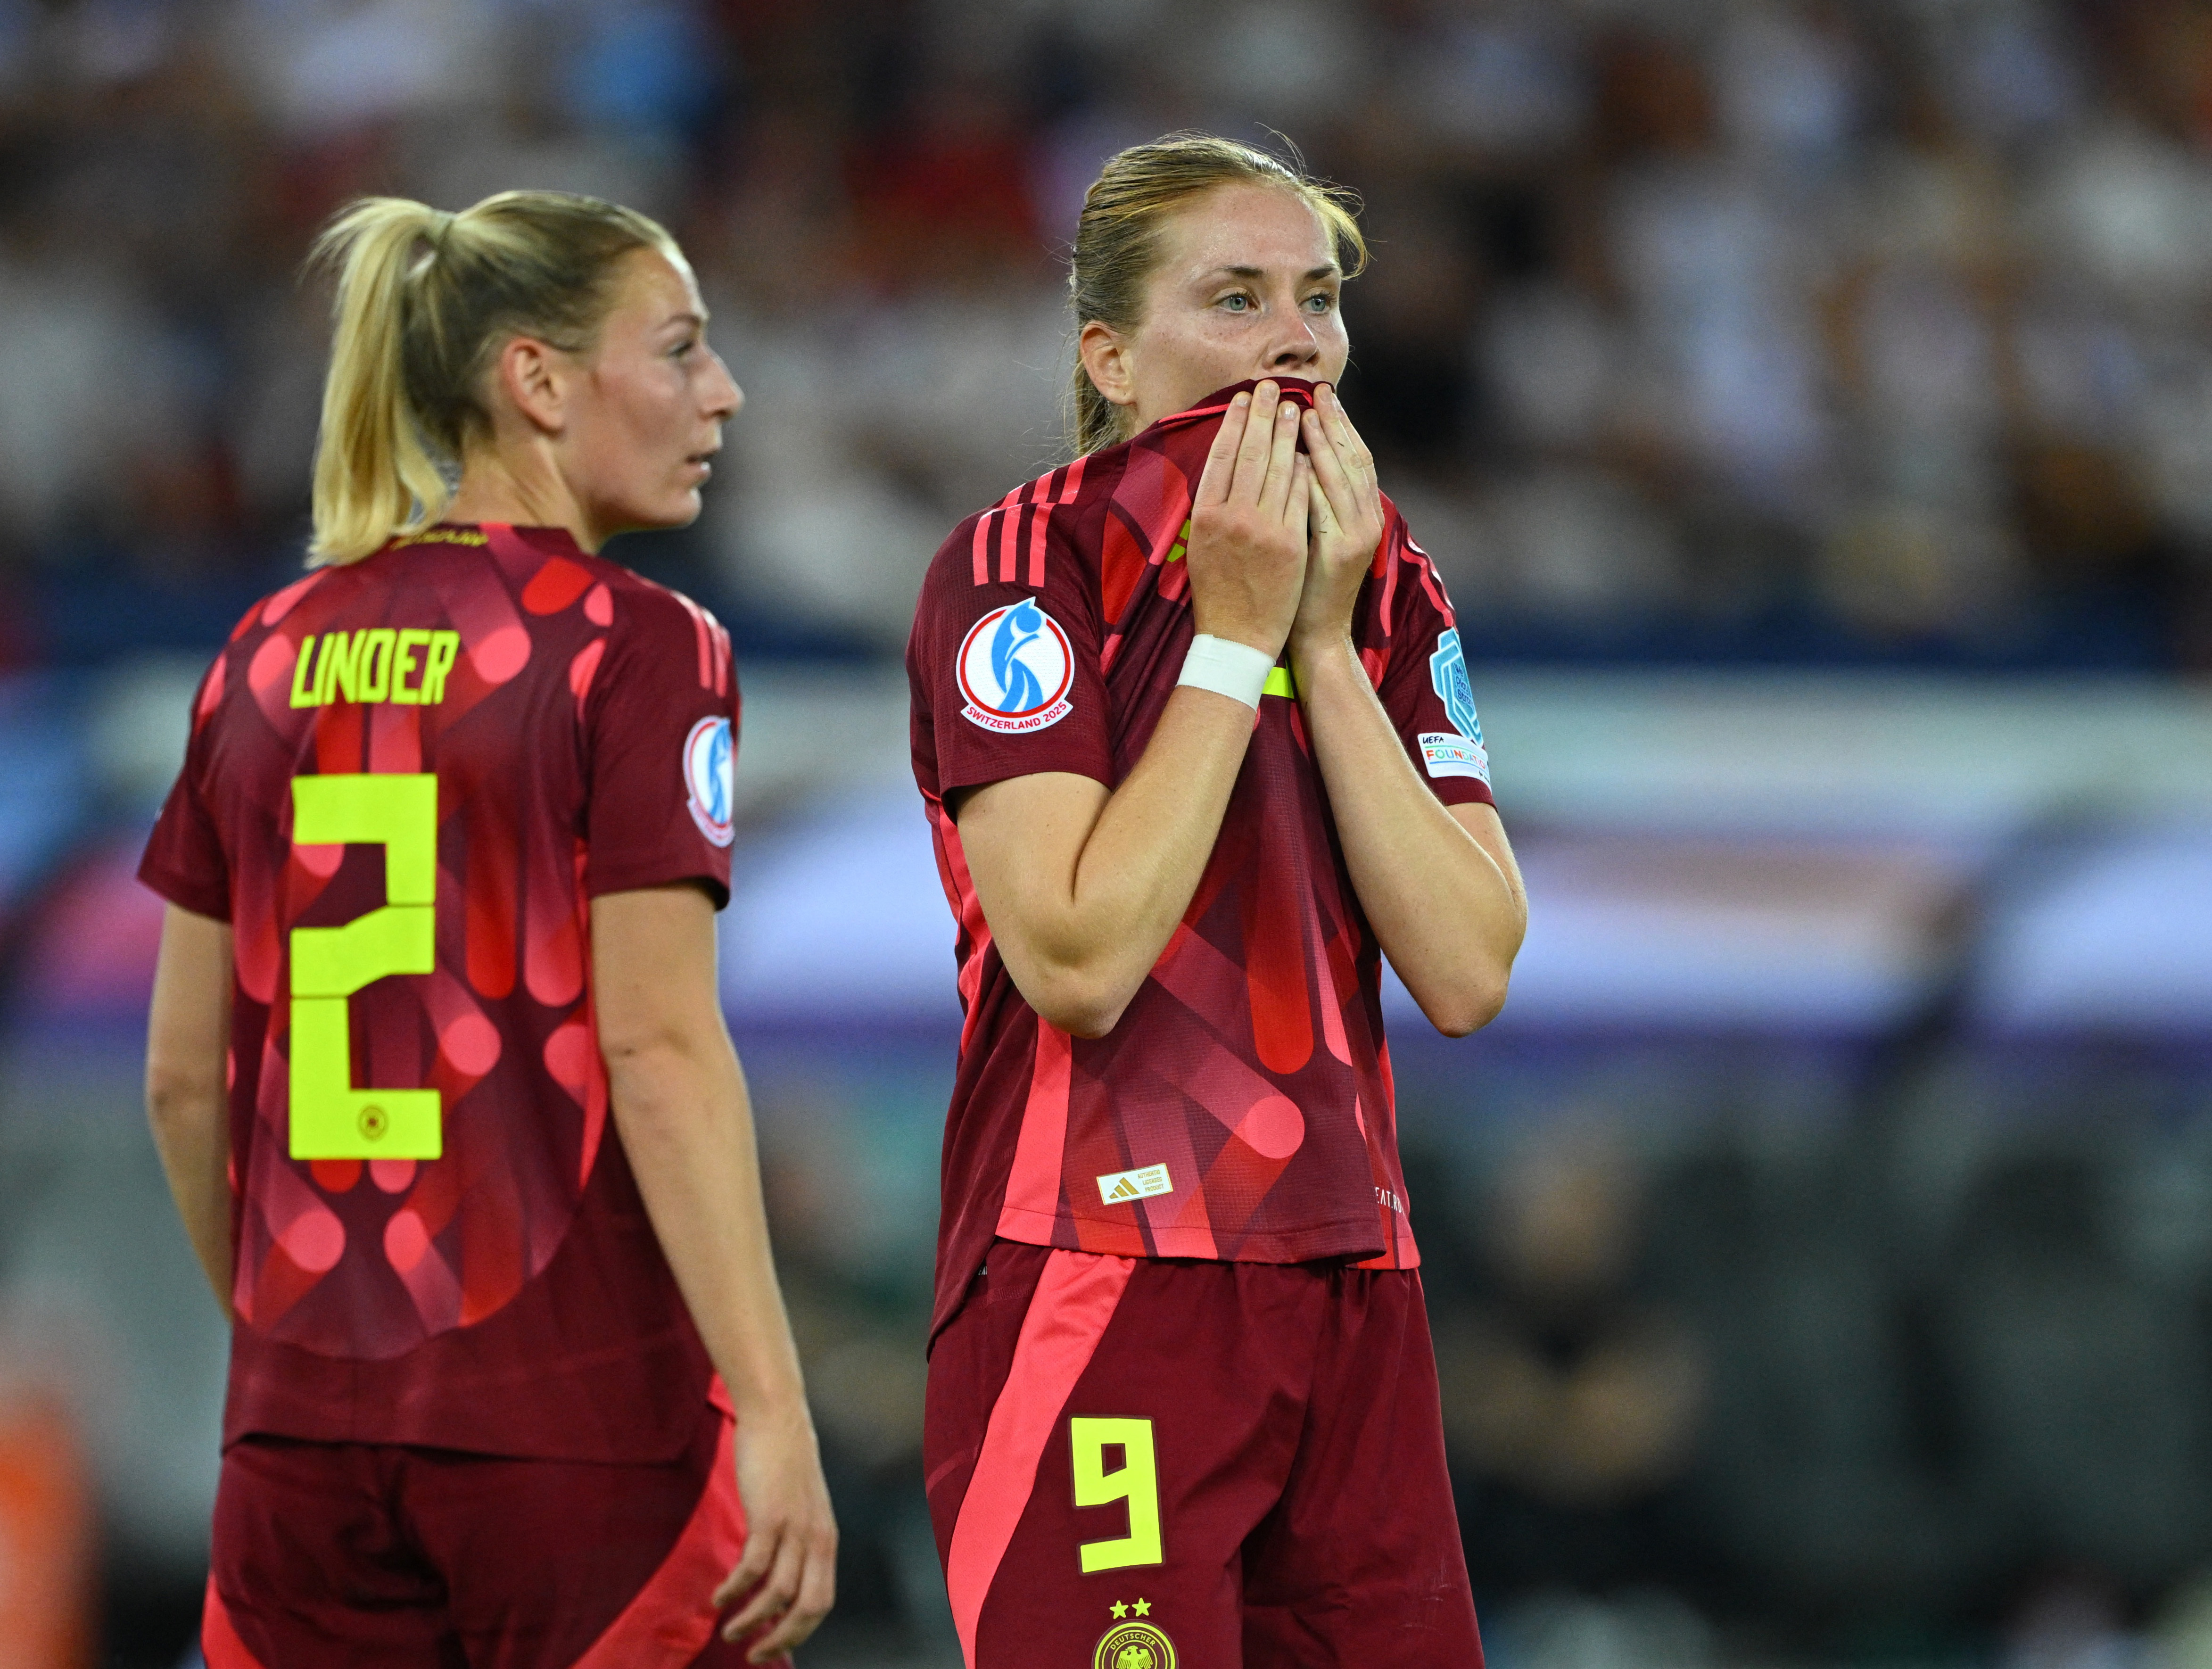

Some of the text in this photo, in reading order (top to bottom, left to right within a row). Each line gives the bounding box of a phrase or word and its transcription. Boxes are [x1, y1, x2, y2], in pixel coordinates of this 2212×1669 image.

[289, 628, 460, 709] LINDER
[966, 701, 1067, 729] SWITZERLAND 2025
[1422, 735, 1444, 744] UEFA
[1426, 749, 1486, 769] FOUNDATIO
[289, 773, 442, 1160] 2
[1071, 1417, 1163, 1573] 9
[1110, 1633, 1156, 1650] DEUTSCHER
